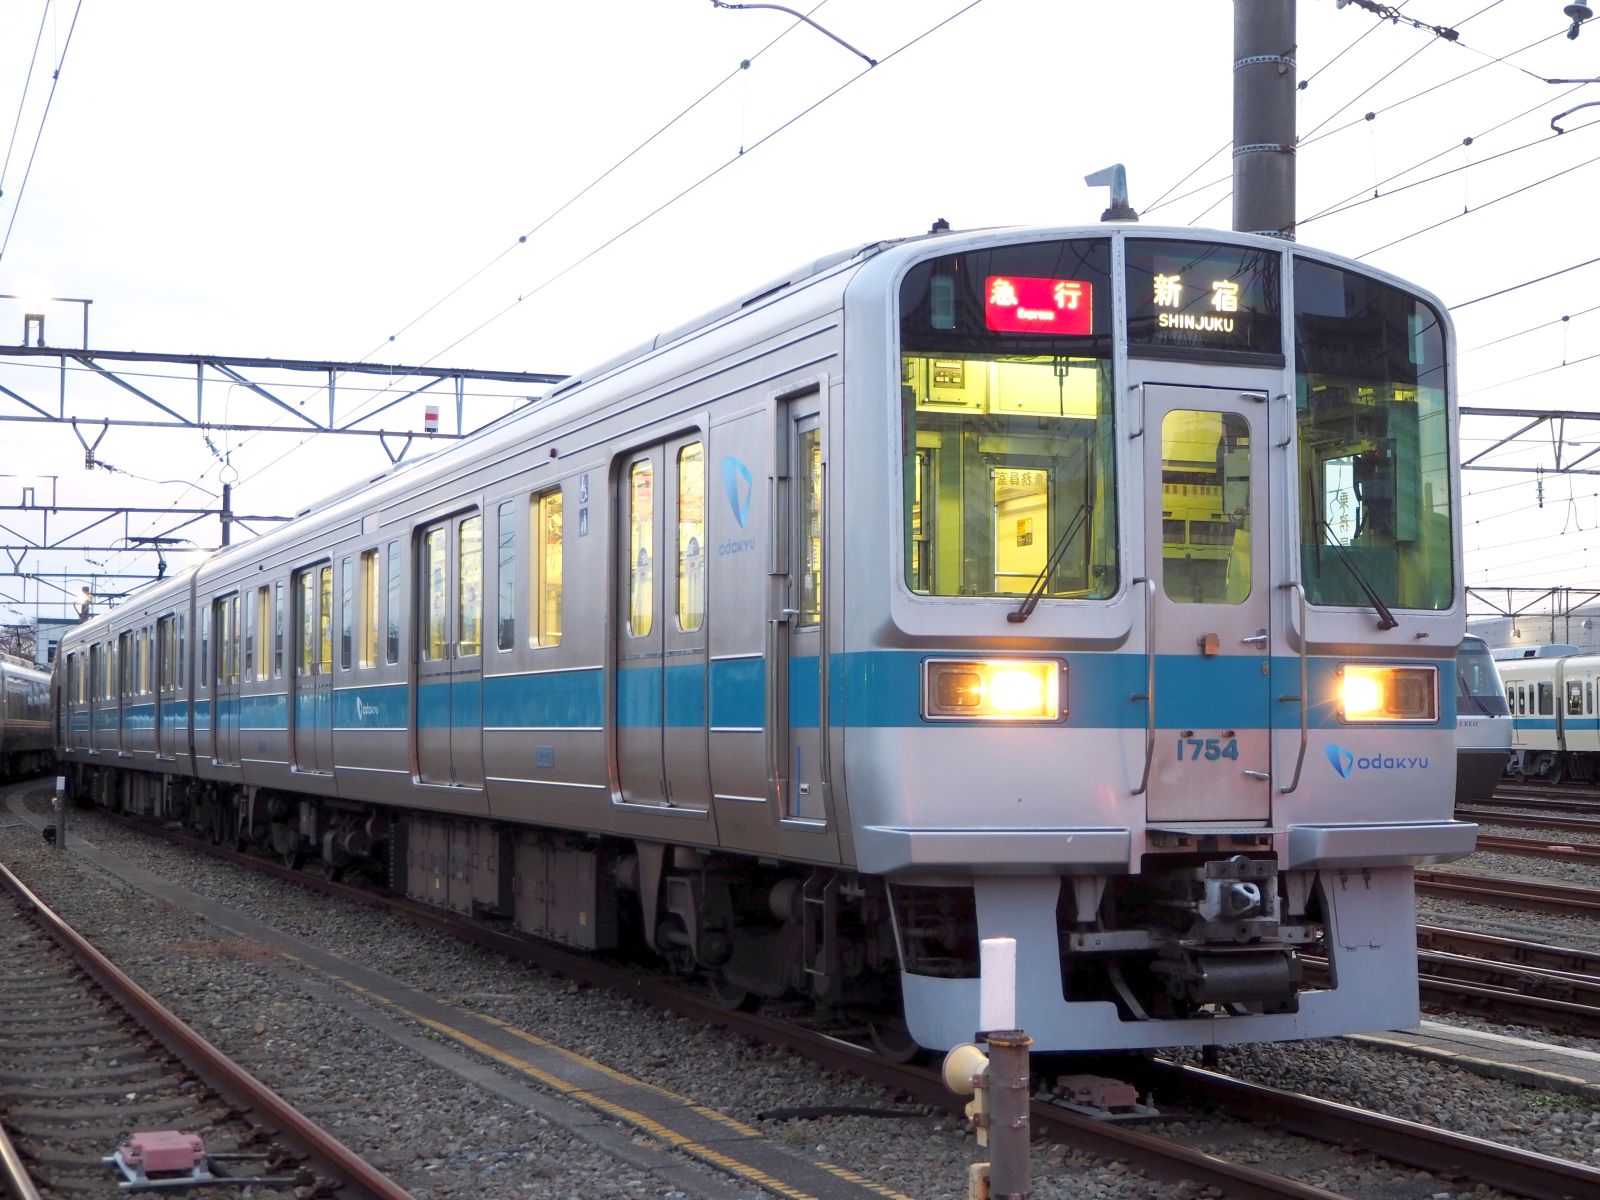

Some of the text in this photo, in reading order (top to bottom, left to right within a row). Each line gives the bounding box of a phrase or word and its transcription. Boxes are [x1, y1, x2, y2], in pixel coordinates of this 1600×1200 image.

[989, 278, 1082, 309] 急行
[1153, 273, 1239, 312] 新宿
[1158, 313, 1234, 332] SHINJUKU
[1177, 739, 1239, 761] 1754
[1357, 753, 1429, 769] odakyu
